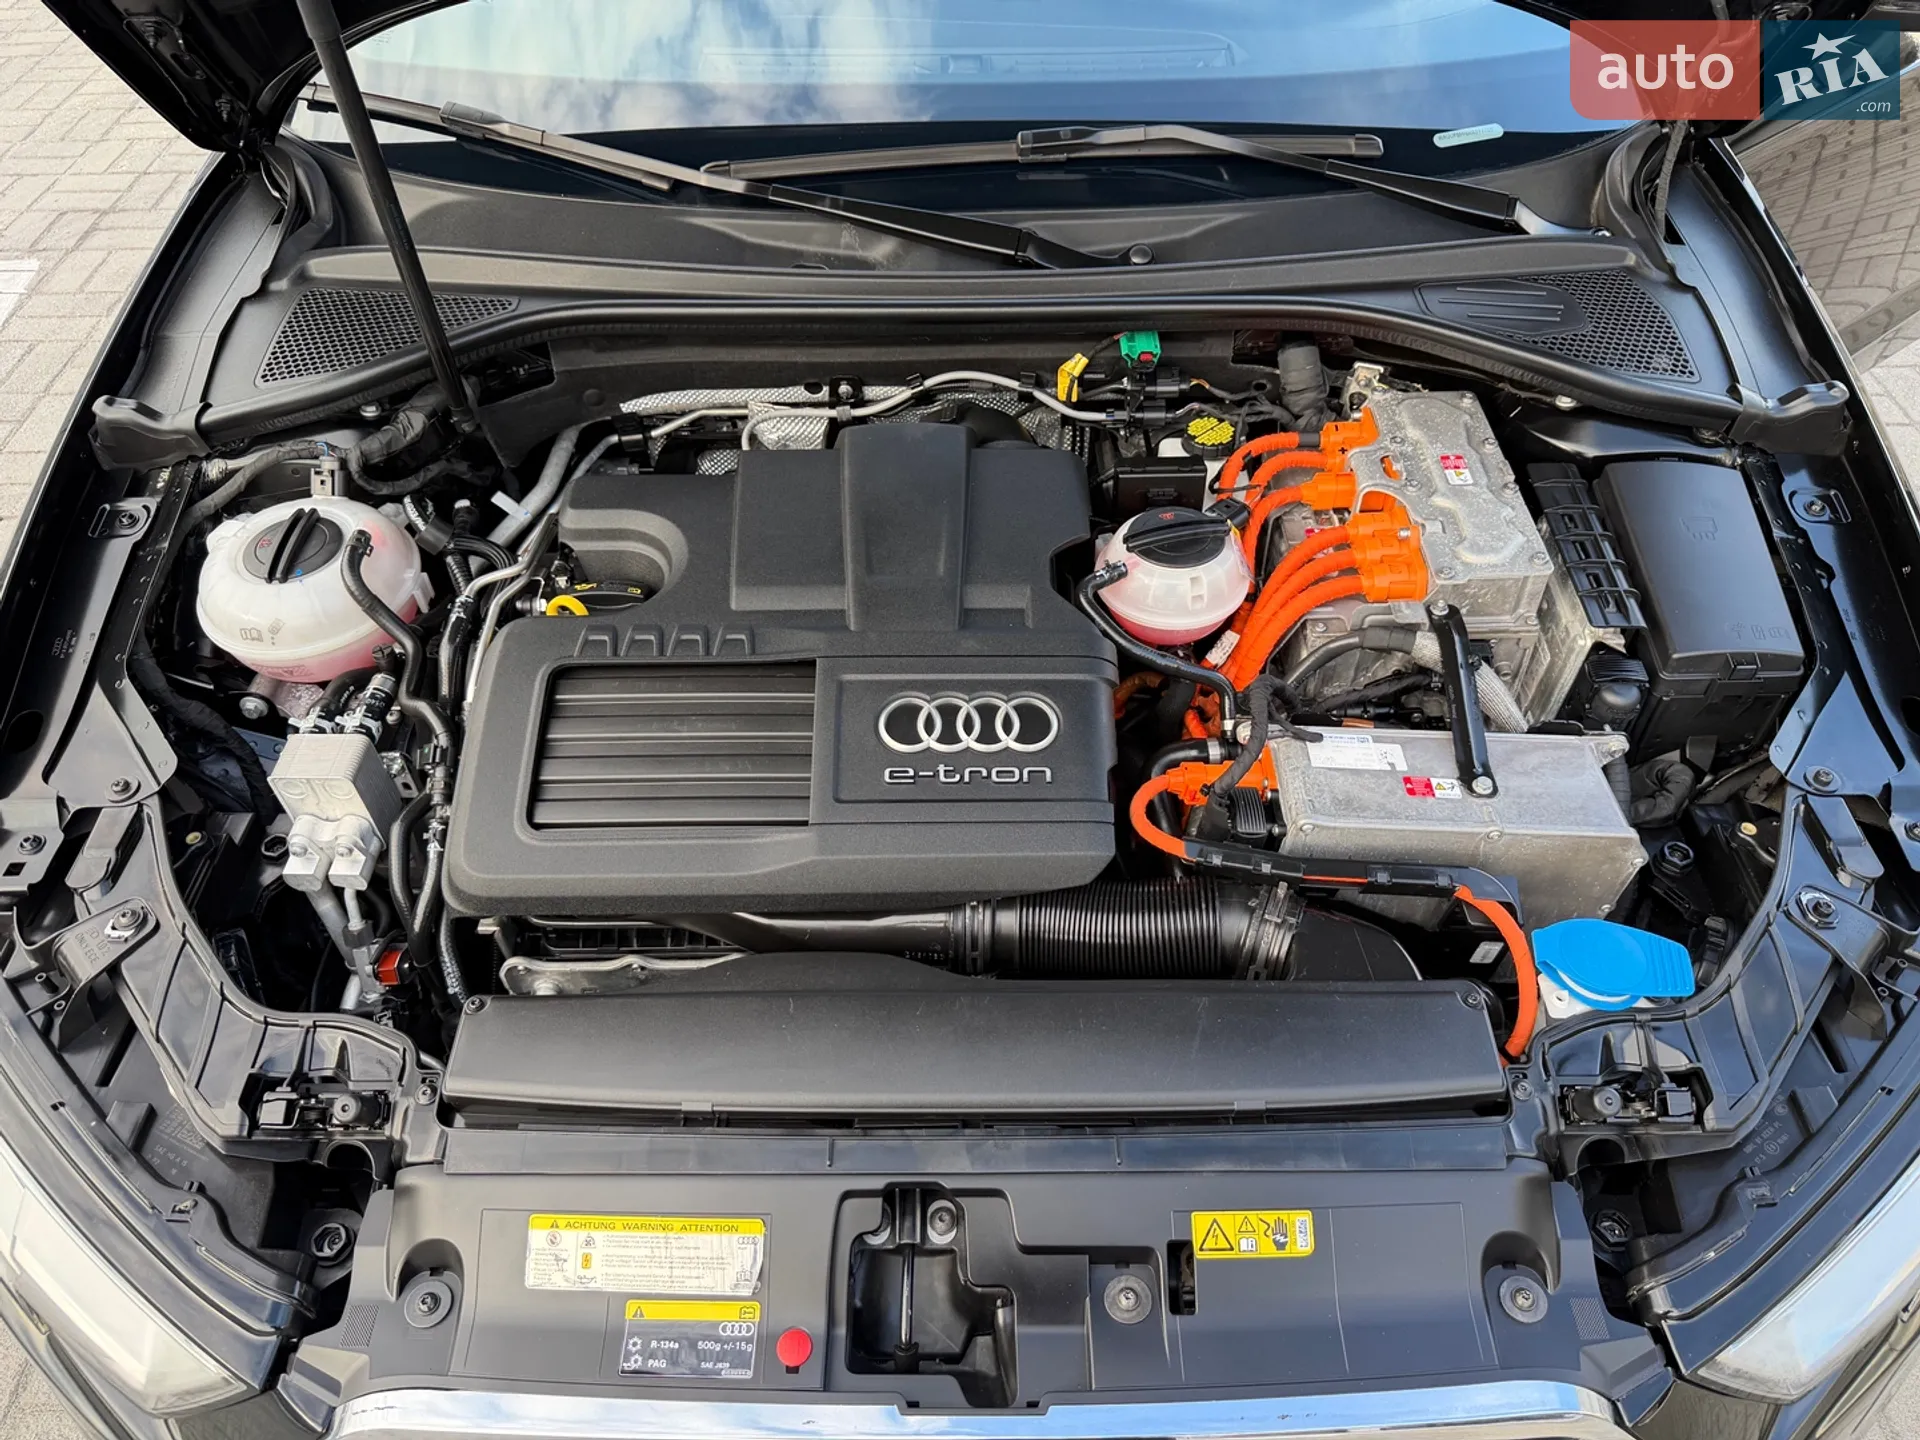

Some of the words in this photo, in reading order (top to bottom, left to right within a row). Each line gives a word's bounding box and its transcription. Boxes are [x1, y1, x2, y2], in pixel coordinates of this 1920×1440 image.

[884, 763, 1053, 784] e-tron
[564, 1221, 616, 1231] ACHTUNG
[622, 1222, 675, 1232] WARNING
[680, 1223, 739, 1233] ATTENTION
[650, 1340, 680, 1350] R-134a
[648, 1359, 667, 1369] PAG
